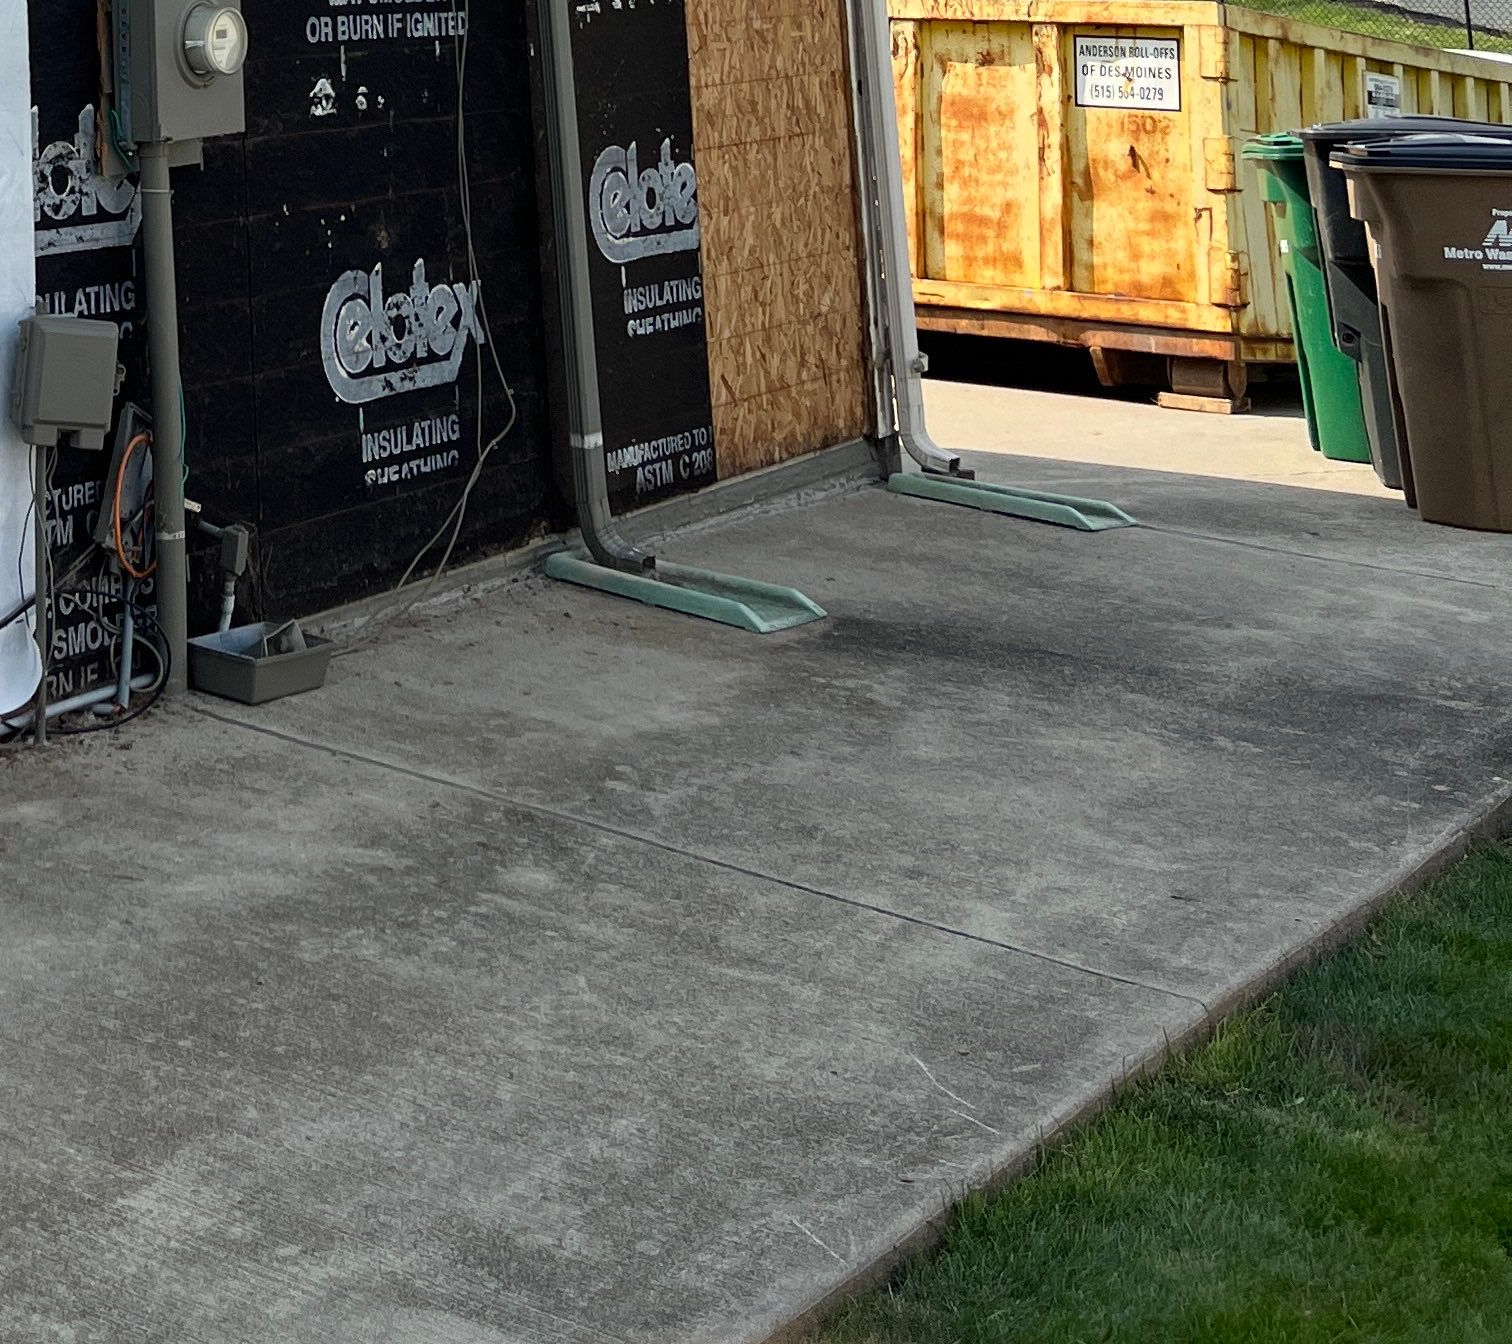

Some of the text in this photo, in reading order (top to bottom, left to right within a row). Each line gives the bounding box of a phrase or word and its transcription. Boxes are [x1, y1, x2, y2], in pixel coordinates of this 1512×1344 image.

[305, 11, 469, 44] OR BURN IF IGNITED
[1078, 44, 1176, 60] ANDERSON ROLL-OFFS
[1081, 64, 1173, 80] OF DES MOINES
[1090, 84, 1115, 101] (515)
[1443, 246, 1484, 260] Metro
[623, 276, 703, 315] INSULATING
[320, 257, 488, 404] Celotex
[361, 412, 461, 464] INSULATING
[606, 428, 708, 474] MANUFACTURED TO
[636, 457, 675, 494] ASTM
[692, 450, 714, 476] 208
